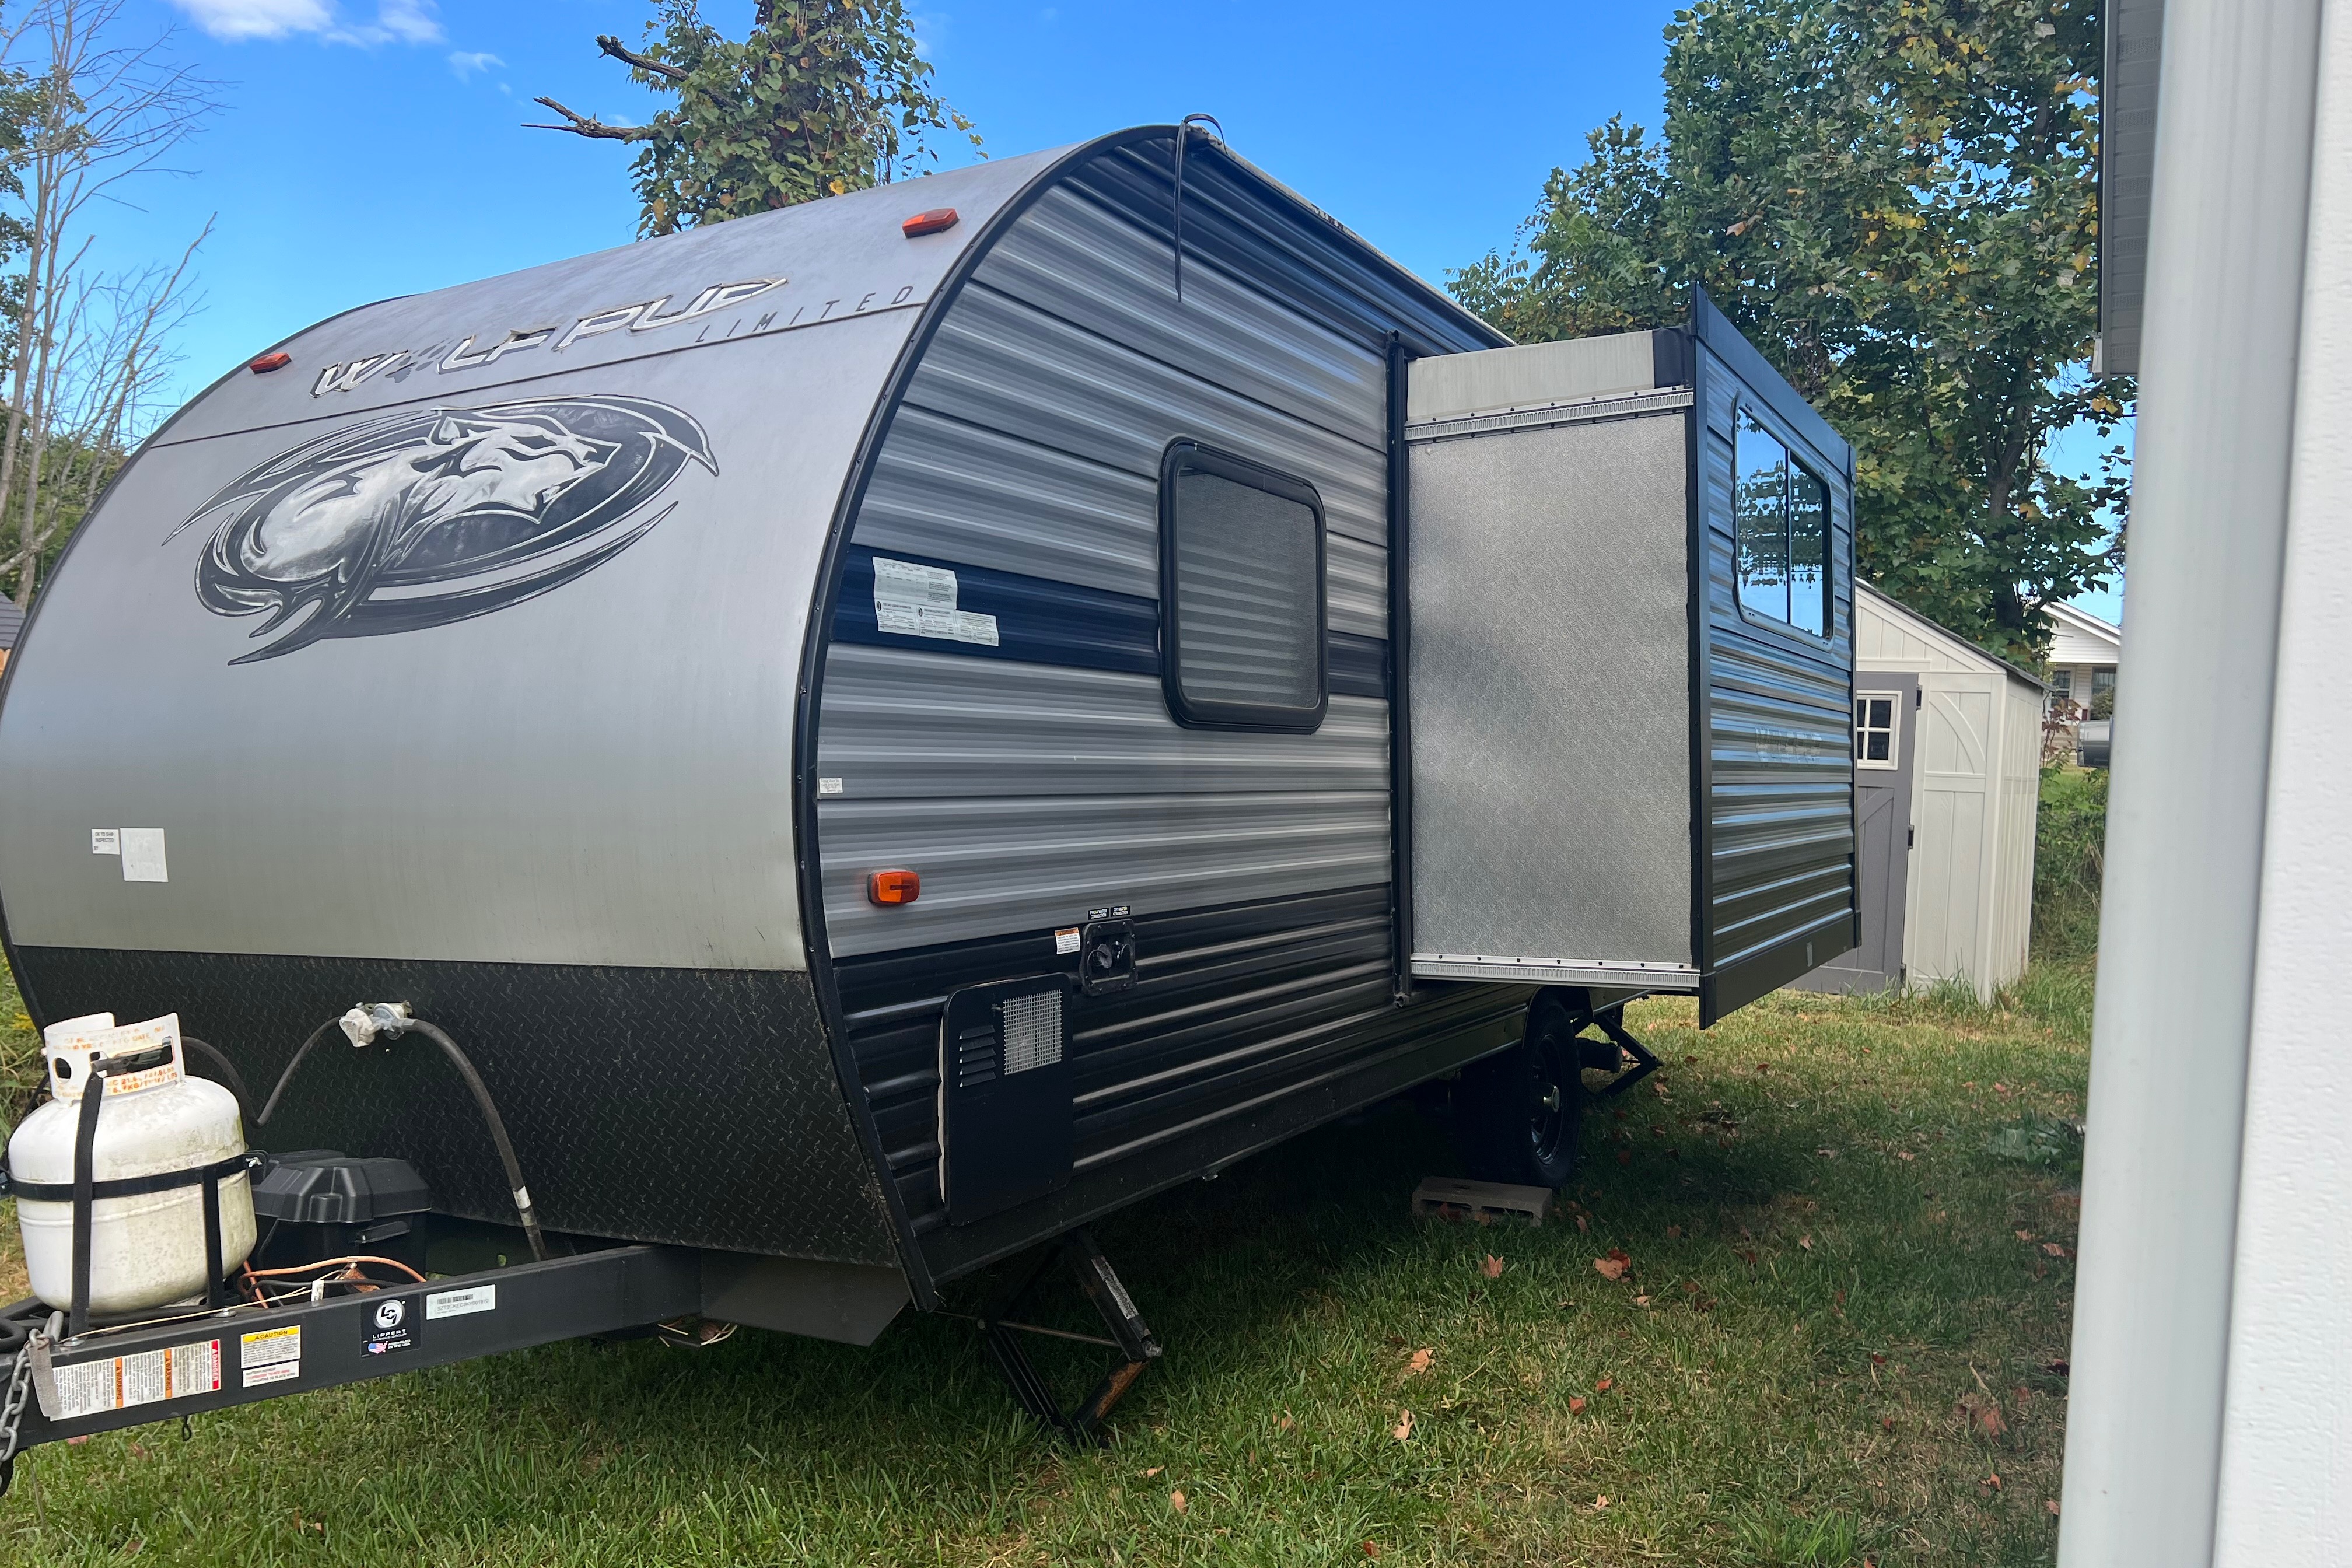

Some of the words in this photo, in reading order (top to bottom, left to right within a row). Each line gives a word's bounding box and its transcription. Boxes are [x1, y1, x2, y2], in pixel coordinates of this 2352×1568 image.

[695, 285, 914, 343] LIMITED
[260, 1330, 288, 1339] CAUTION
[372, 1329, 406, 1339] LIPPERT
